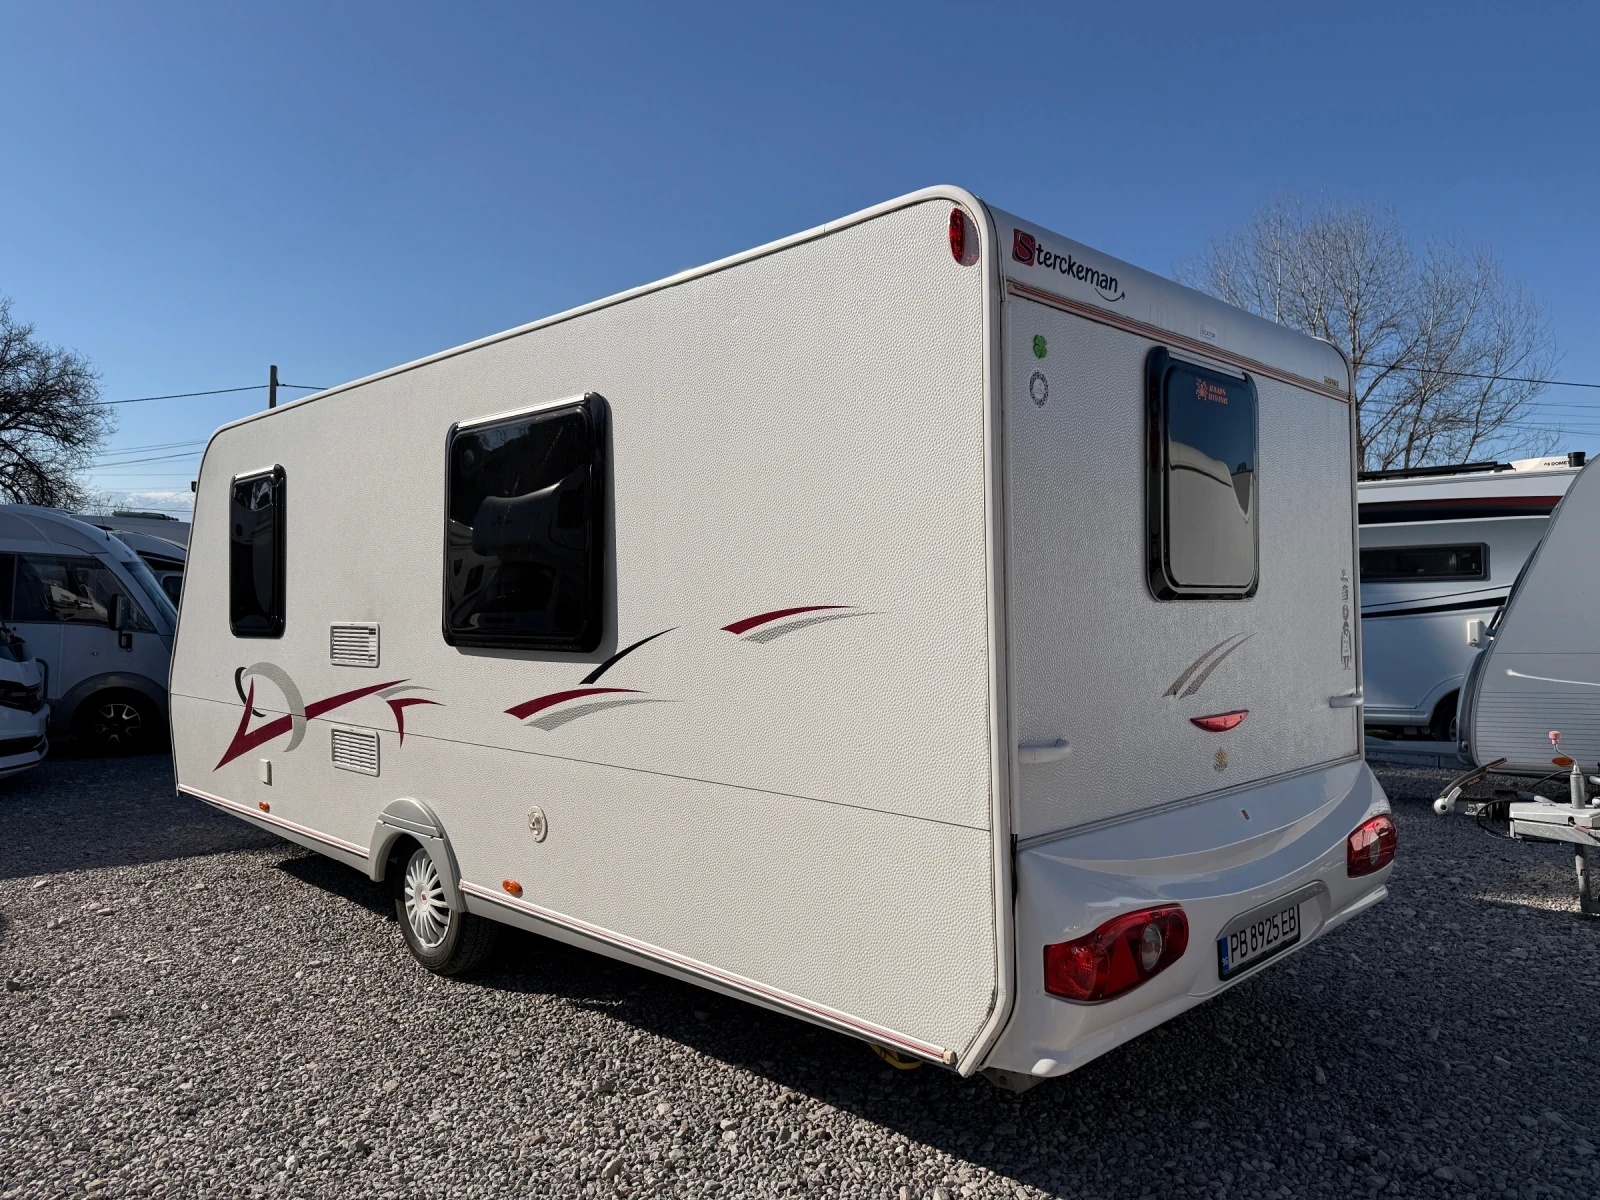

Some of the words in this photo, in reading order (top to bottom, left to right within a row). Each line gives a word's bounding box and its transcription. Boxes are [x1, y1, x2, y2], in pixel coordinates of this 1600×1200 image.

[1013, 230, 1118, 293] Sterckeman
[1230, 929, 1248, 963] PB
[1250, 915, 1279, 952] 8925
[1281, 907, 1296, 936] EB
